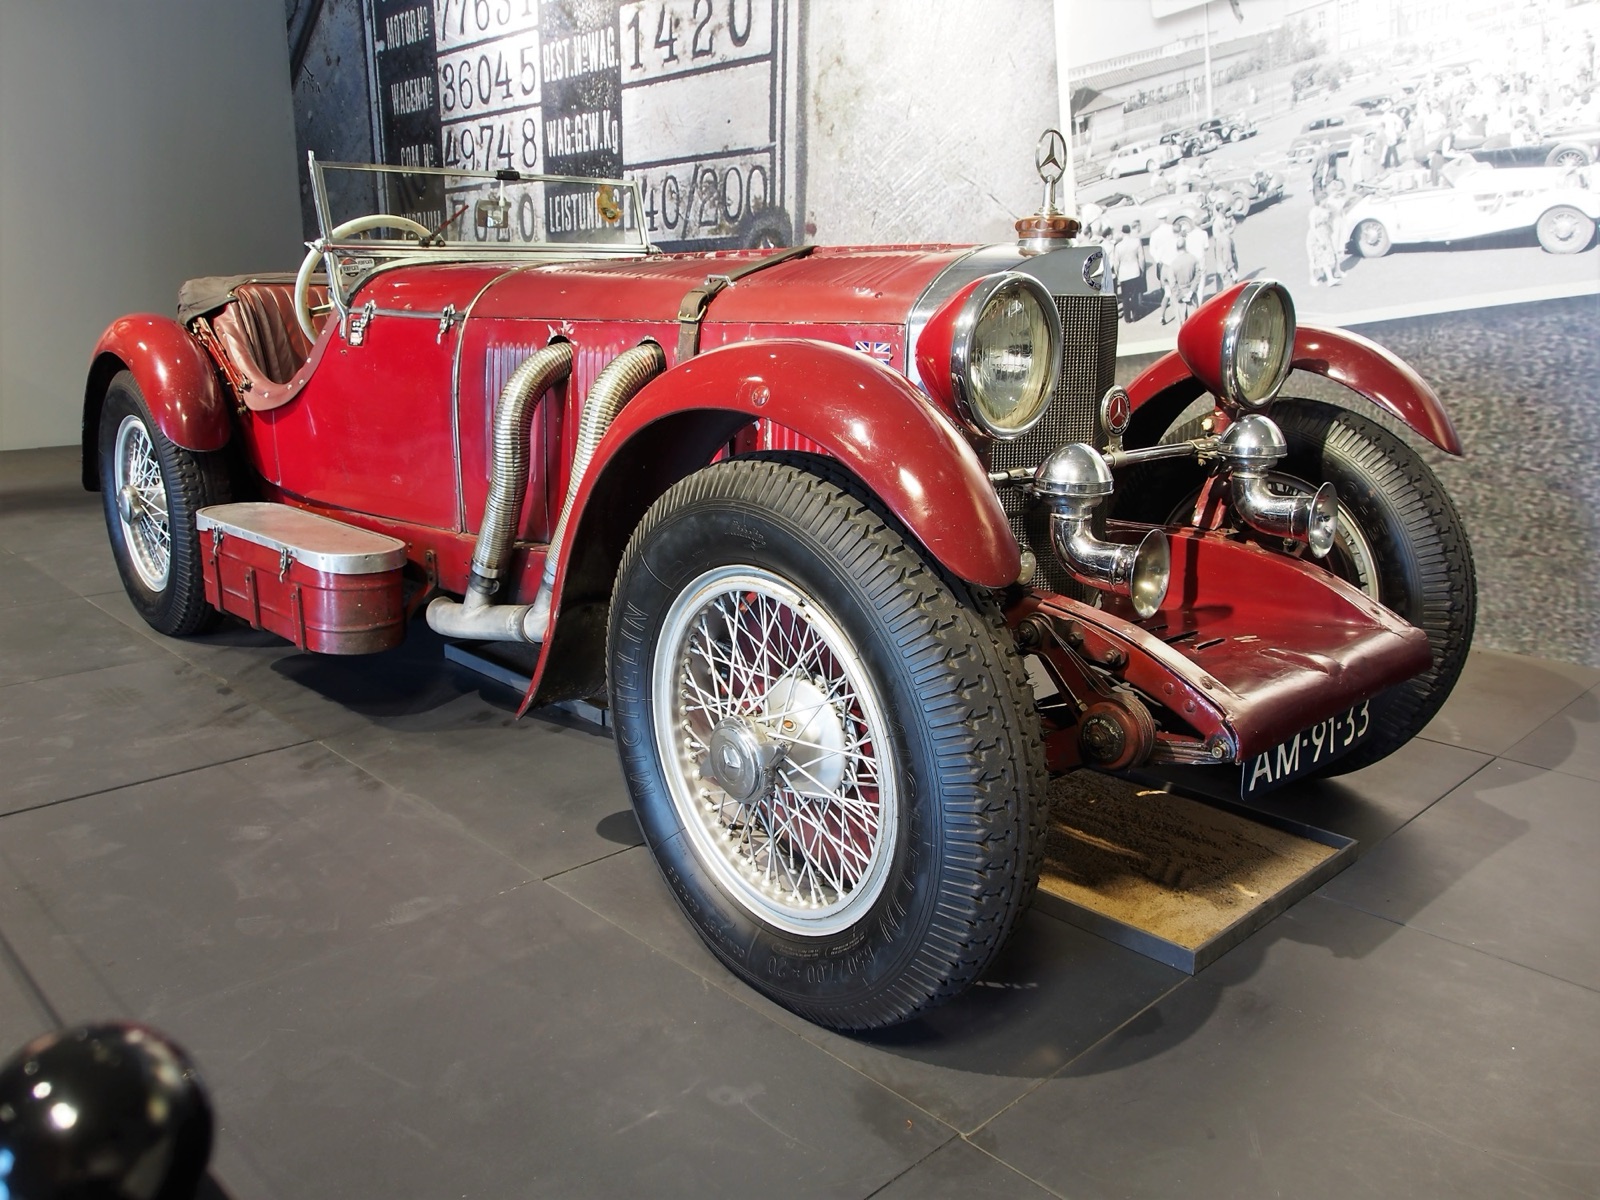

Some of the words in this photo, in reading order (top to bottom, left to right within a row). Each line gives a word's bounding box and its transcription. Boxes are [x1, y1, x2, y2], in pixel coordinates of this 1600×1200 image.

[386, 10, 416, 50] MOTOR
[627, 0, 753, 71] 1420
[442, 46, 537, 112] 36045
[445, 117, 538, 173] 49748
[614, 602, 657, 798] MICHELIN
